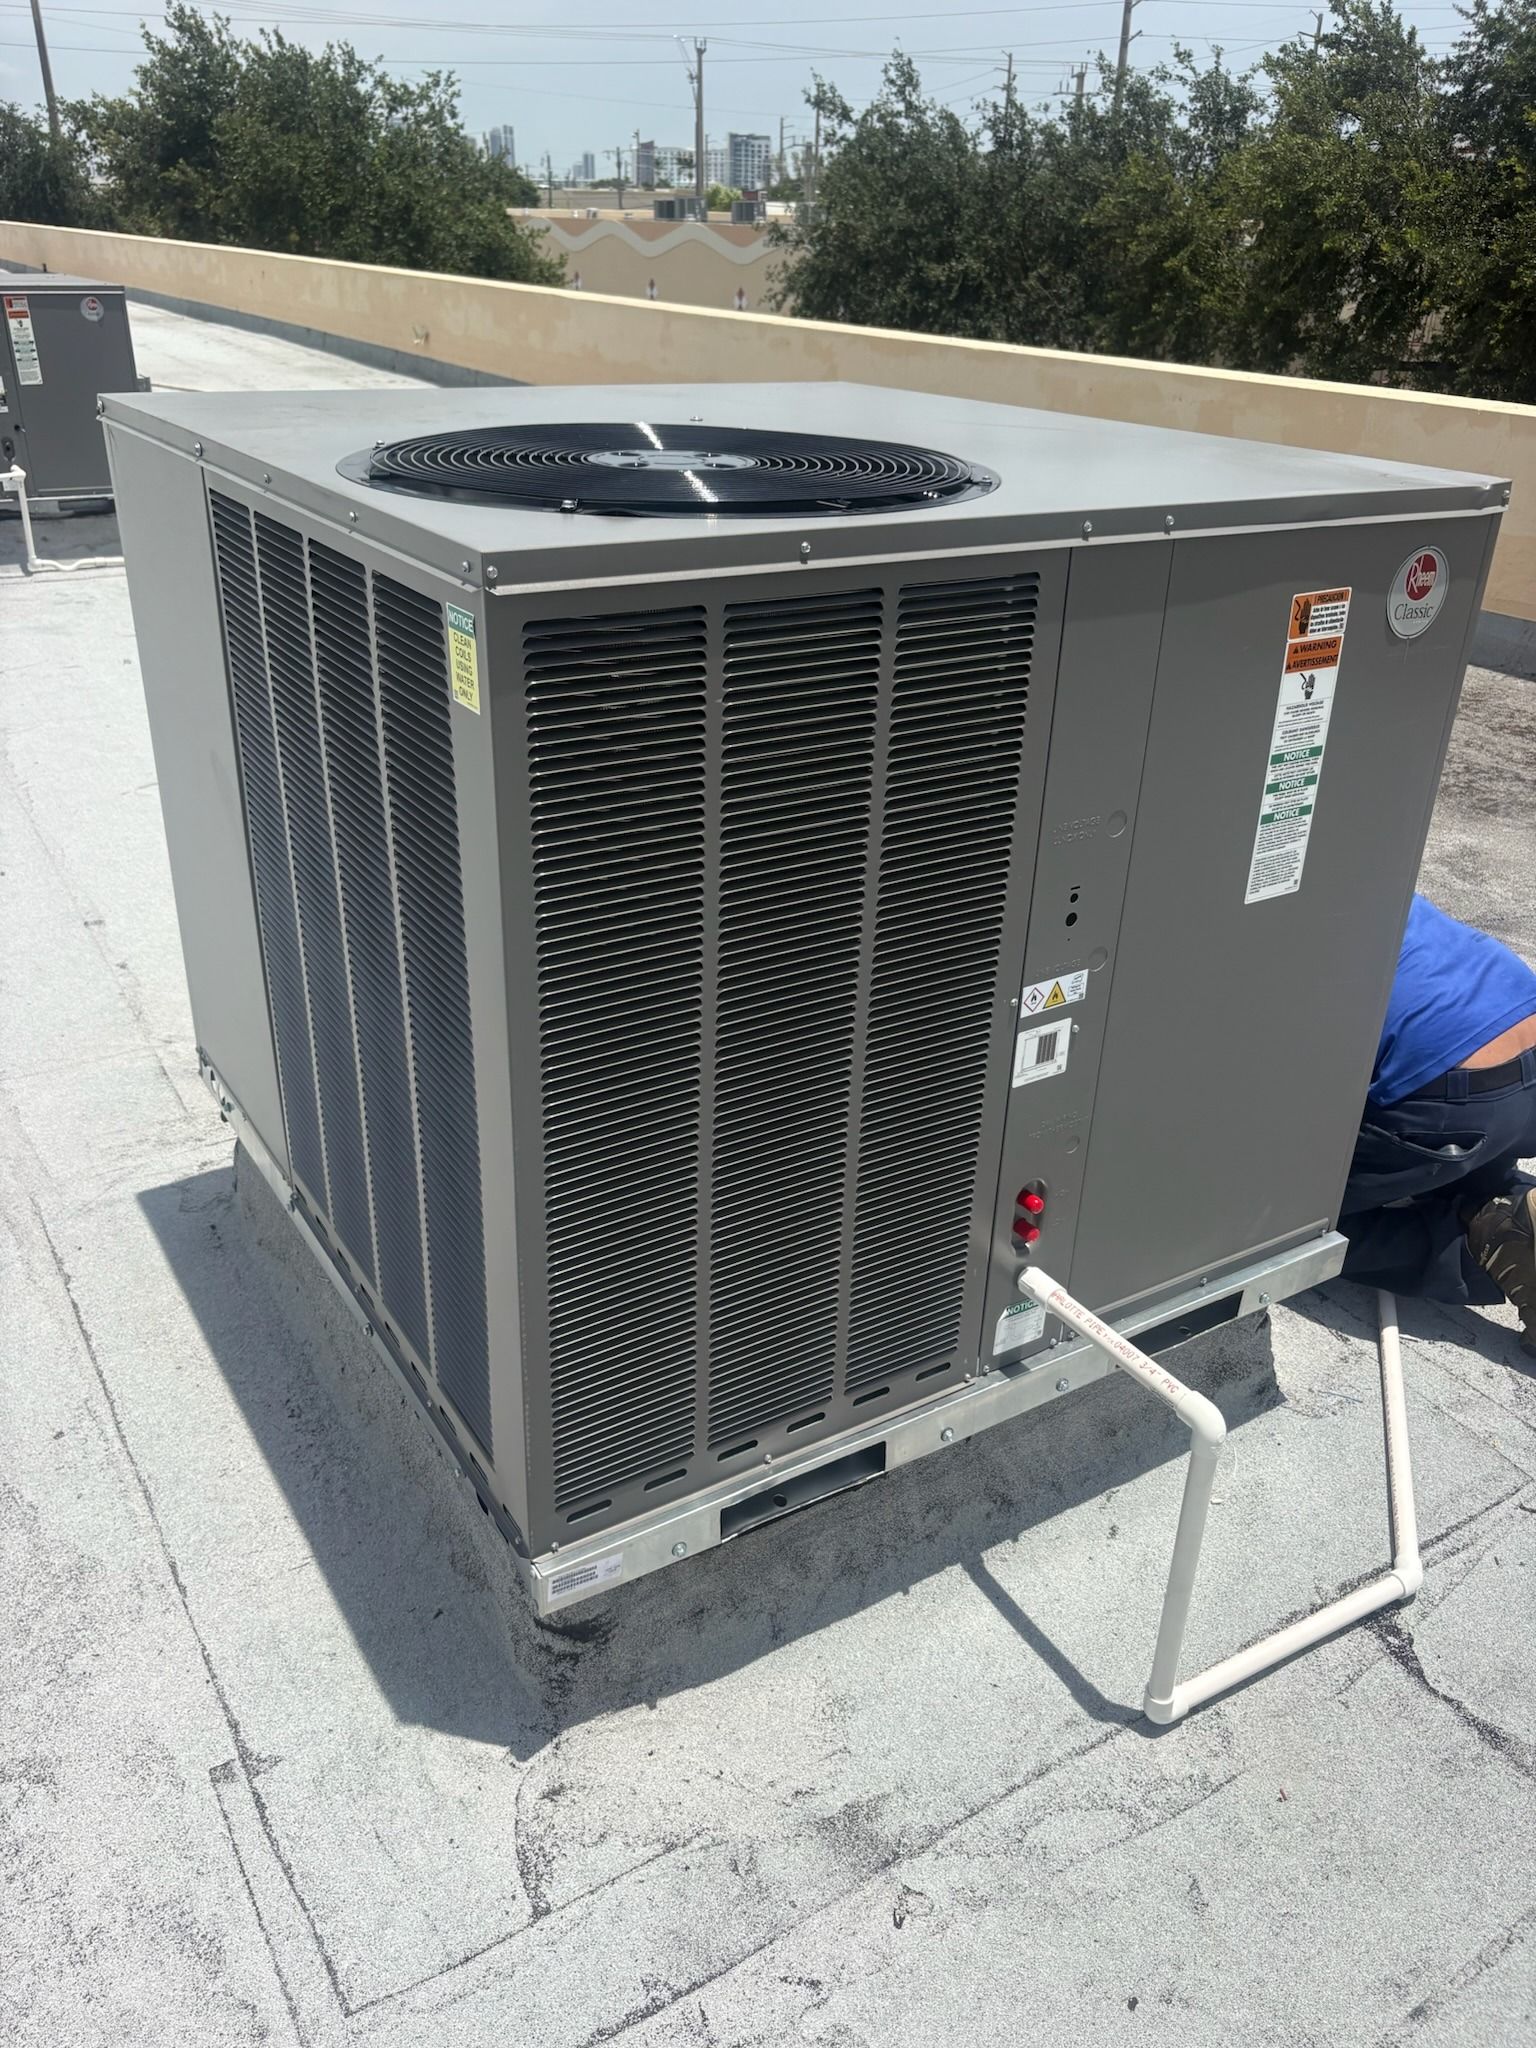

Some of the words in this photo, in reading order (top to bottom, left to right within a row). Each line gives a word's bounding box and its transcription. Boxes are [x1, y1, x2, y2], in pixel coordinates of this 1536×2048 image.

[1407, 555, 1436, 593] Rheem
[1394, 603, 1434, 621] Classic
[448, 610, 474, 632] NOTICE
[453, 632, 472, 650] CLEAN
[1300, 640, 1337, 653] WARNING
[455, 646, 472, 663] COILS
[1292, 653, 1339, 669] AVERTISSEMENT
[455, 659, 473, 676] USING
[456, 671, 475, 690] WATER
[458, 686, 474, 701] ONLY
[1283, 749, 1311, 761] NOTICE
[1279, 778, 1305, 790] NOTICE
[1273, 808, 1300, 821] NOTICE
[1050, 1290, 1086, 1319] ARLOTTE
[1084, 1317, 1106, 1336] PIPE
[1113, 1341, 1140, 1361] 04007
[1161, 1378, 1180, 1394] PVC
